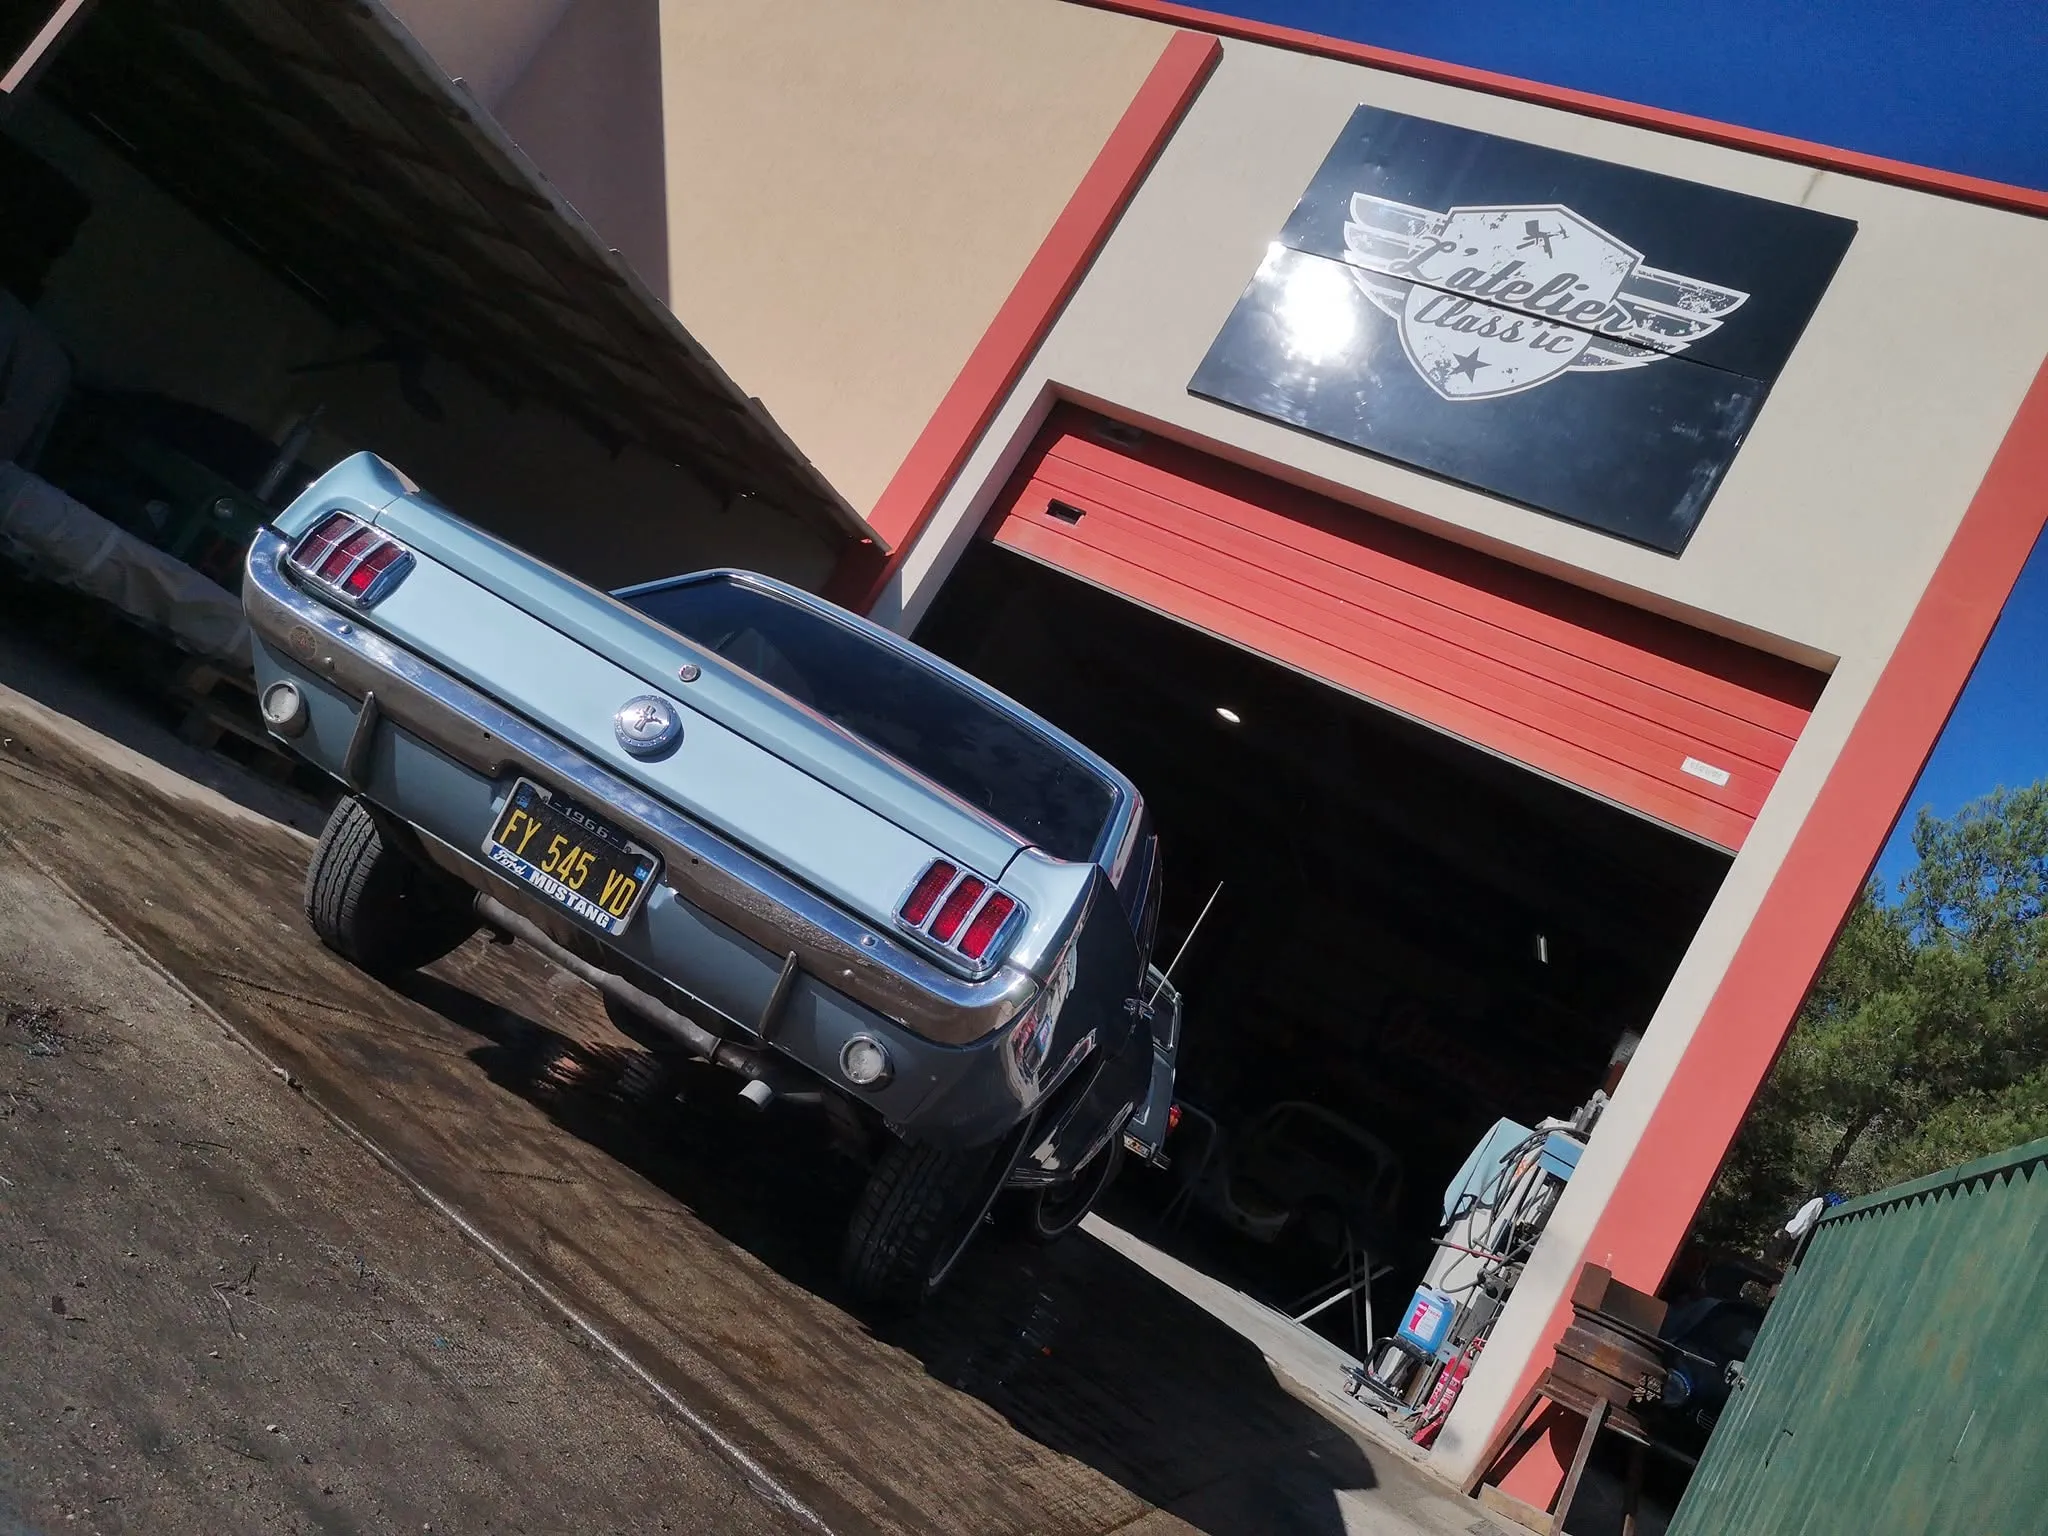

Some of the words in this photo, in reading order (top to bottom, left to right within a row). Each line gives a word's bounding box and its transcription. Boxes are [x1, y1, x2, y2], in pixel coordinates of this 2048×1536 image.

[1388, 236, 1634, 333] L'atelier
[492, 849, 525, 876] Ford
[528, 869, 610, 929] MUSTANG
[499, 808, 542, 855] FY
[541, 833, 596, 891] 545
[599, 867, 637, 917] VD
